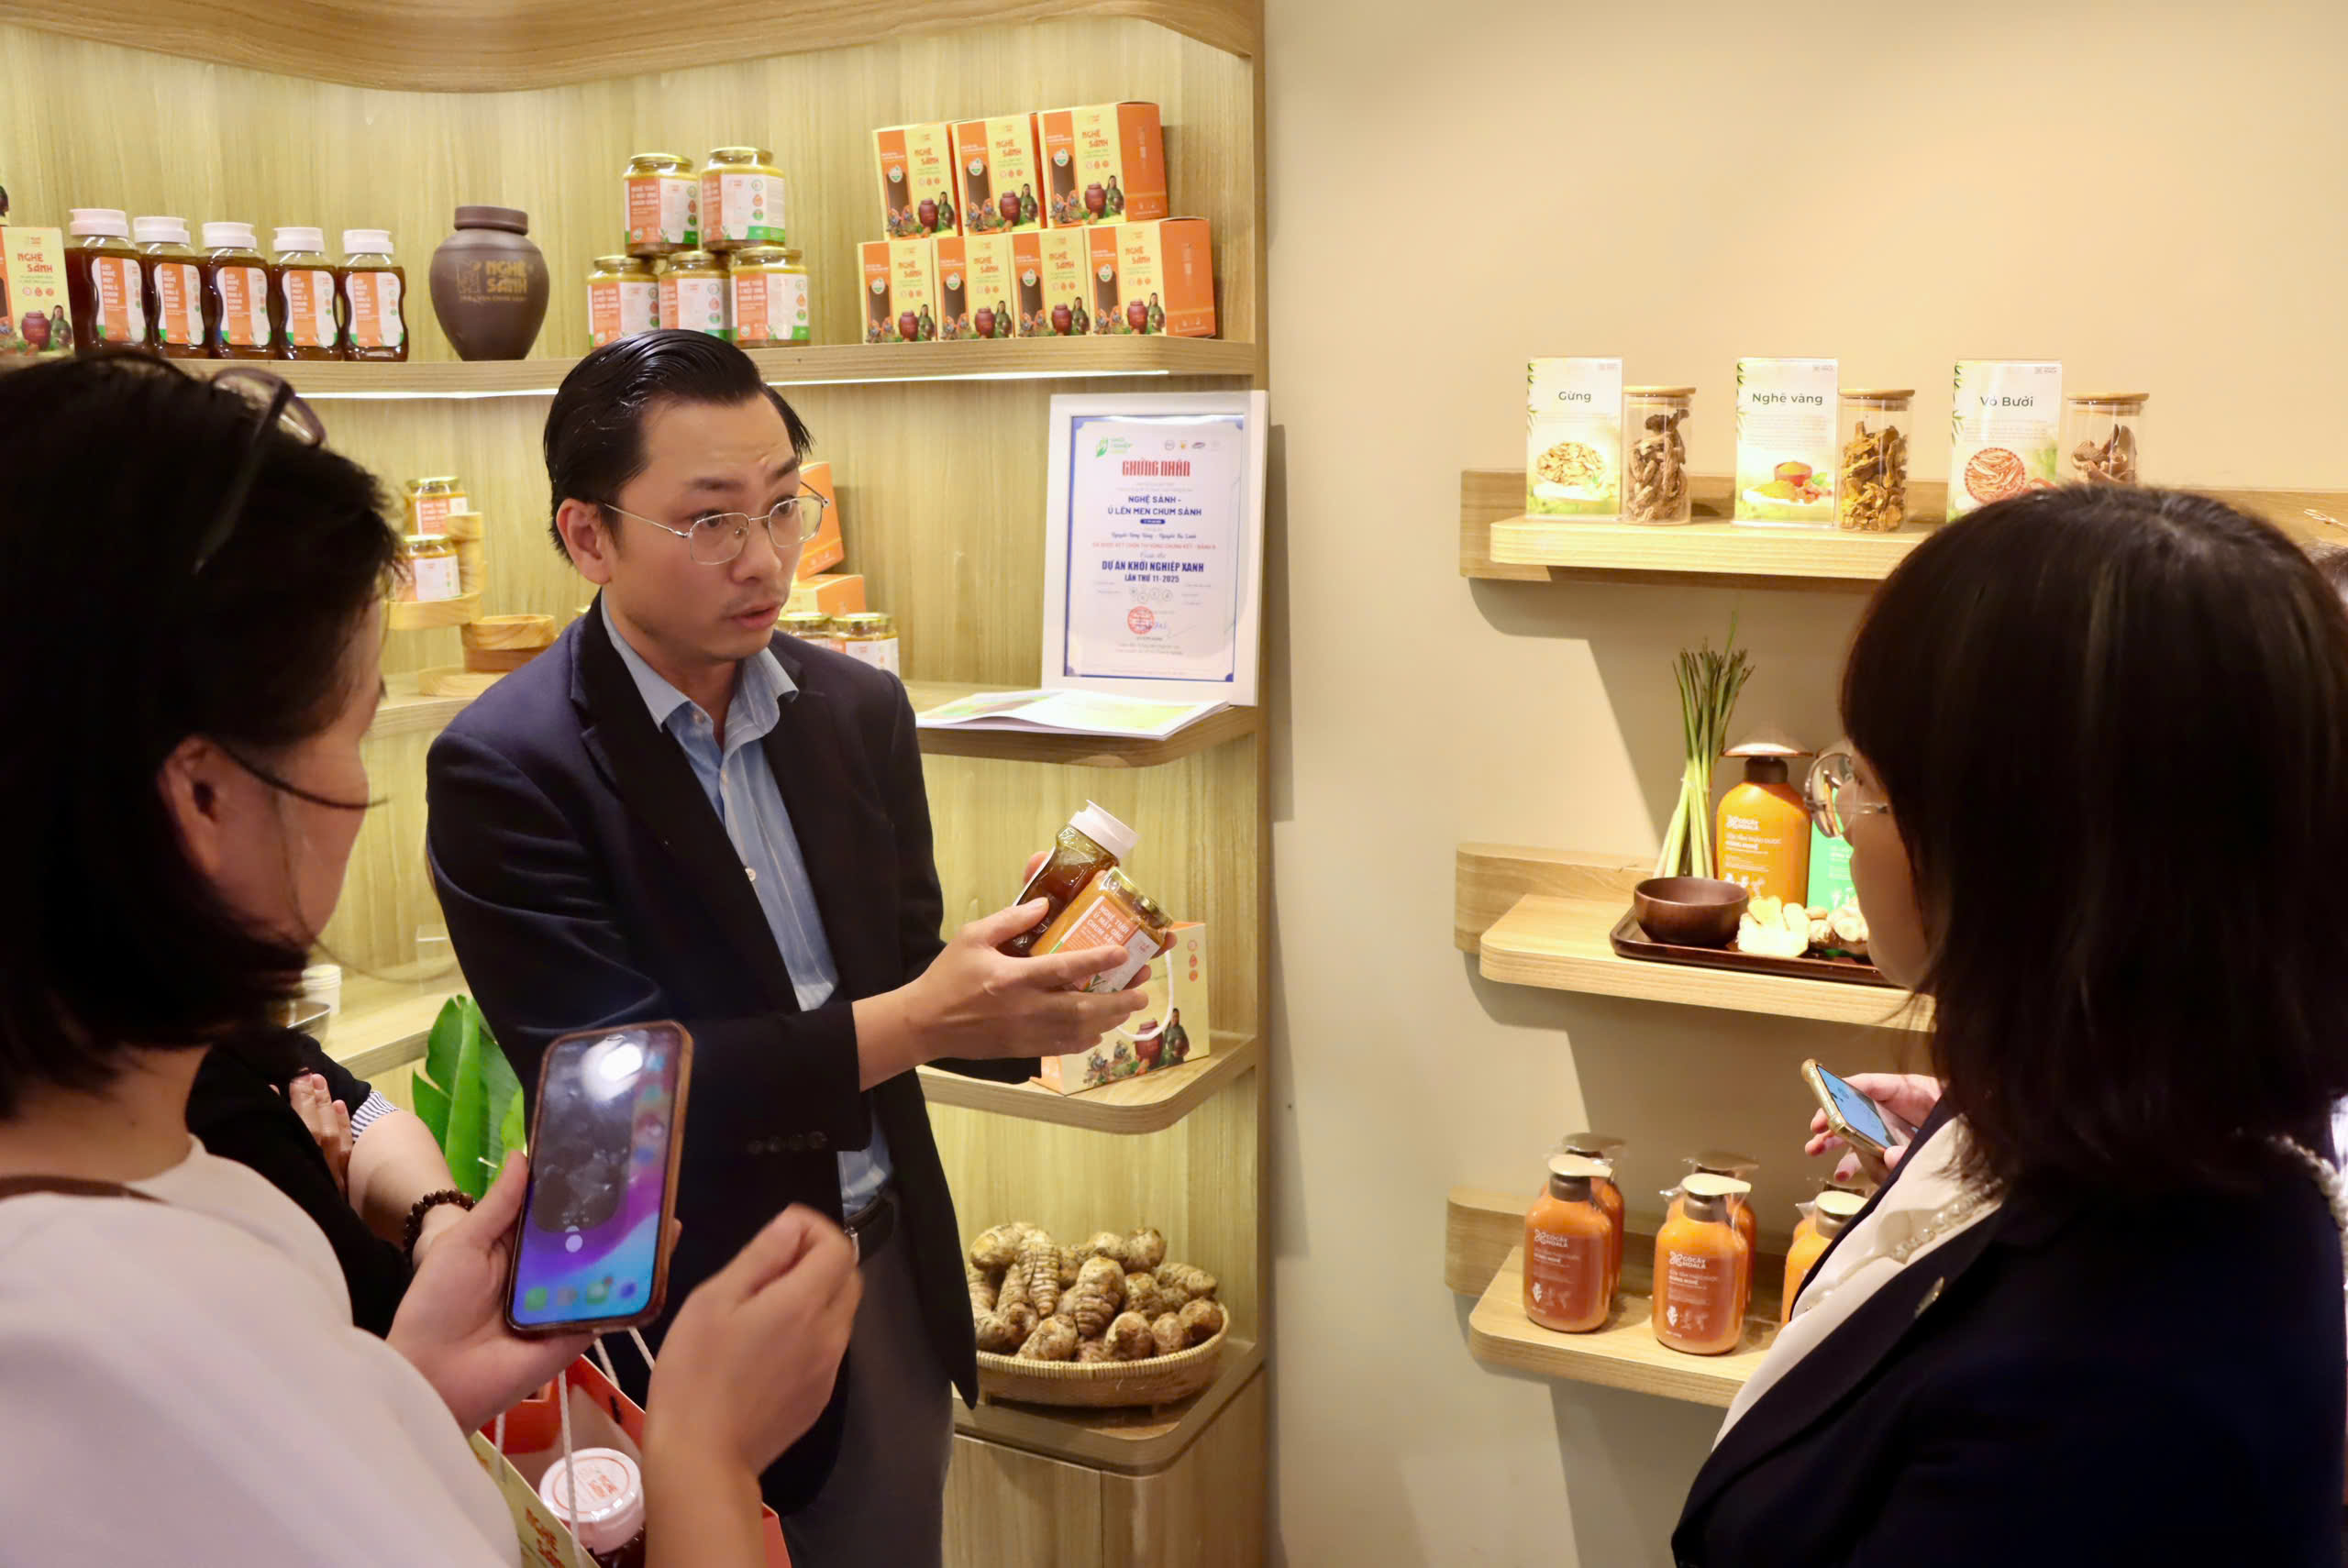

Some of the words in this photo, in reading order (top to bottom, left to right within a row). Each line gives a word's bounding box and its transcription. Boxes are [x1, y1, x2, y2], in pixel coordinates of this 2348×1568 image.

[1558, 391, 1591, 403] Gừng
[1752, 392, 1787, 405] Nghệ
[1790, 392, 1823, 406] vàng
[2001, 395, 2033, 407] Bưởi
[1134, 507, 1151, 515] MEN
[1153, 507, 1177, 516] CHUM
[1181, 562, 1204, 572] XANH
